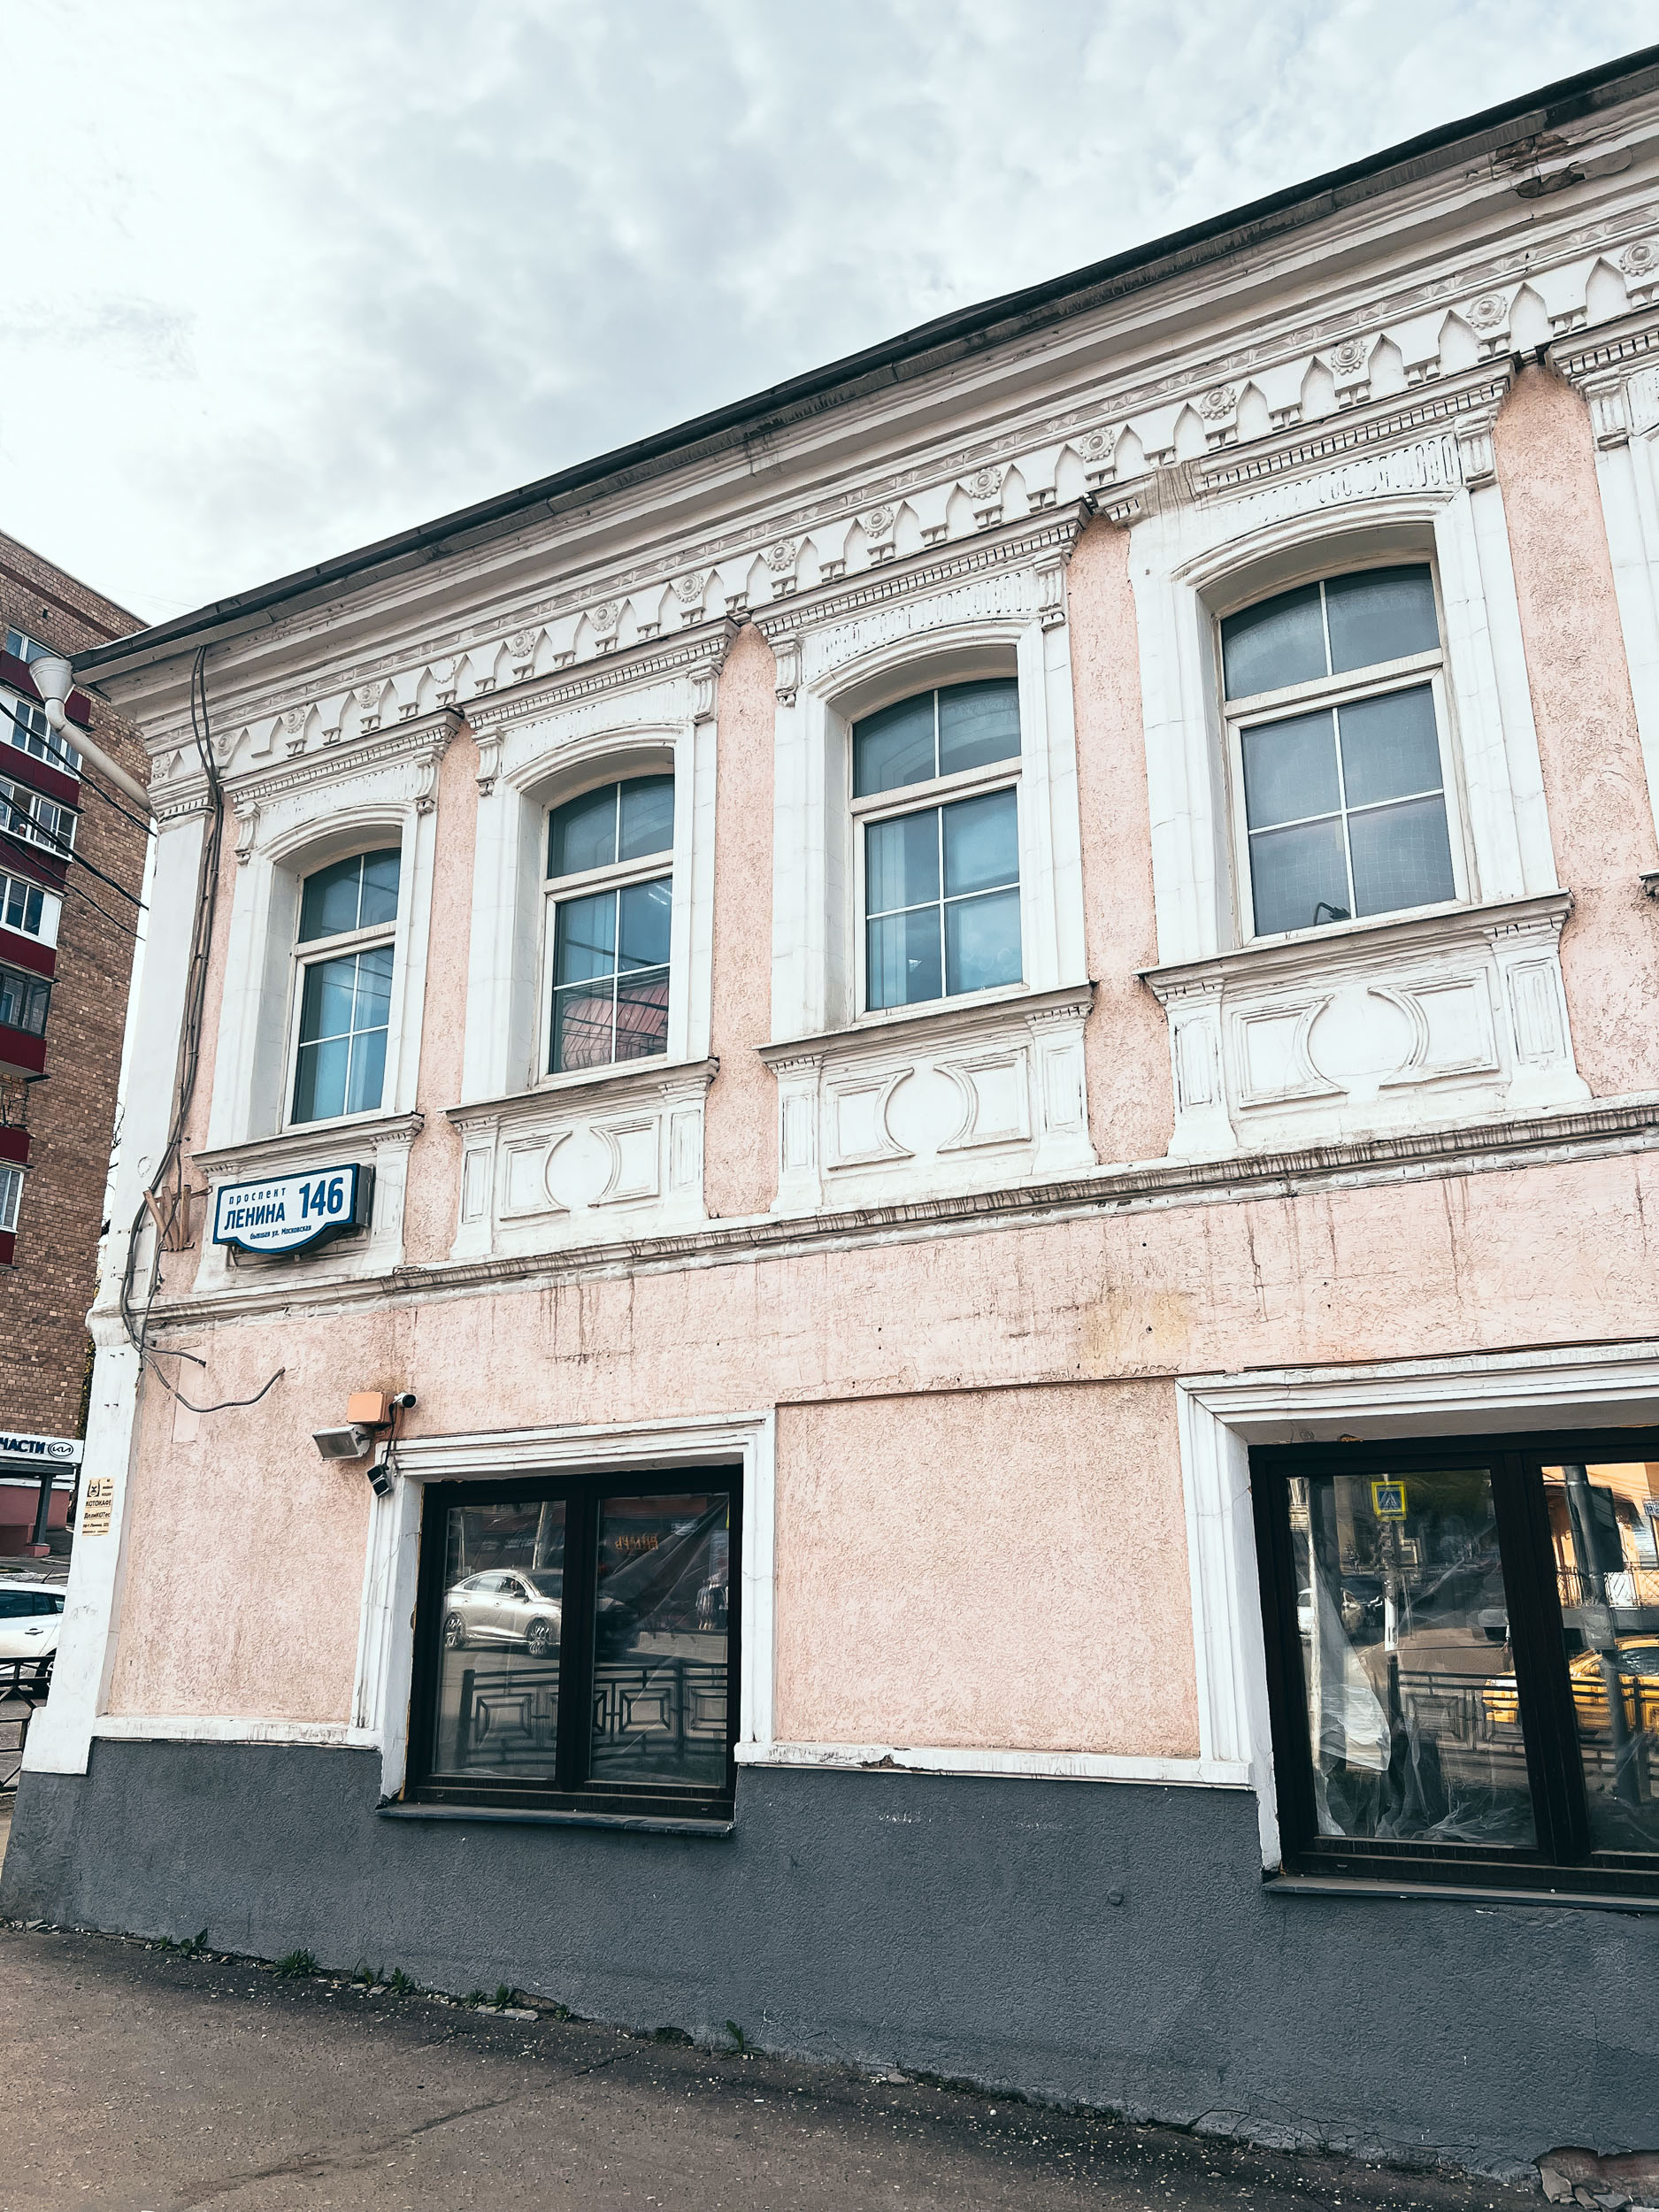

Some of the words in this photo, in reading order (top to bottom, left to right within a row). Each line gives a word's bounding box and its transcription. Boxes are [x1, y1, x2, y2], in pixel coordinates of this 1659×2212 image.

[224, 1202, 285, 1230] ЛЕНИНА
[299, 1177, 343, 1218] 146
[229, 1187, 286, 1205] проспект
